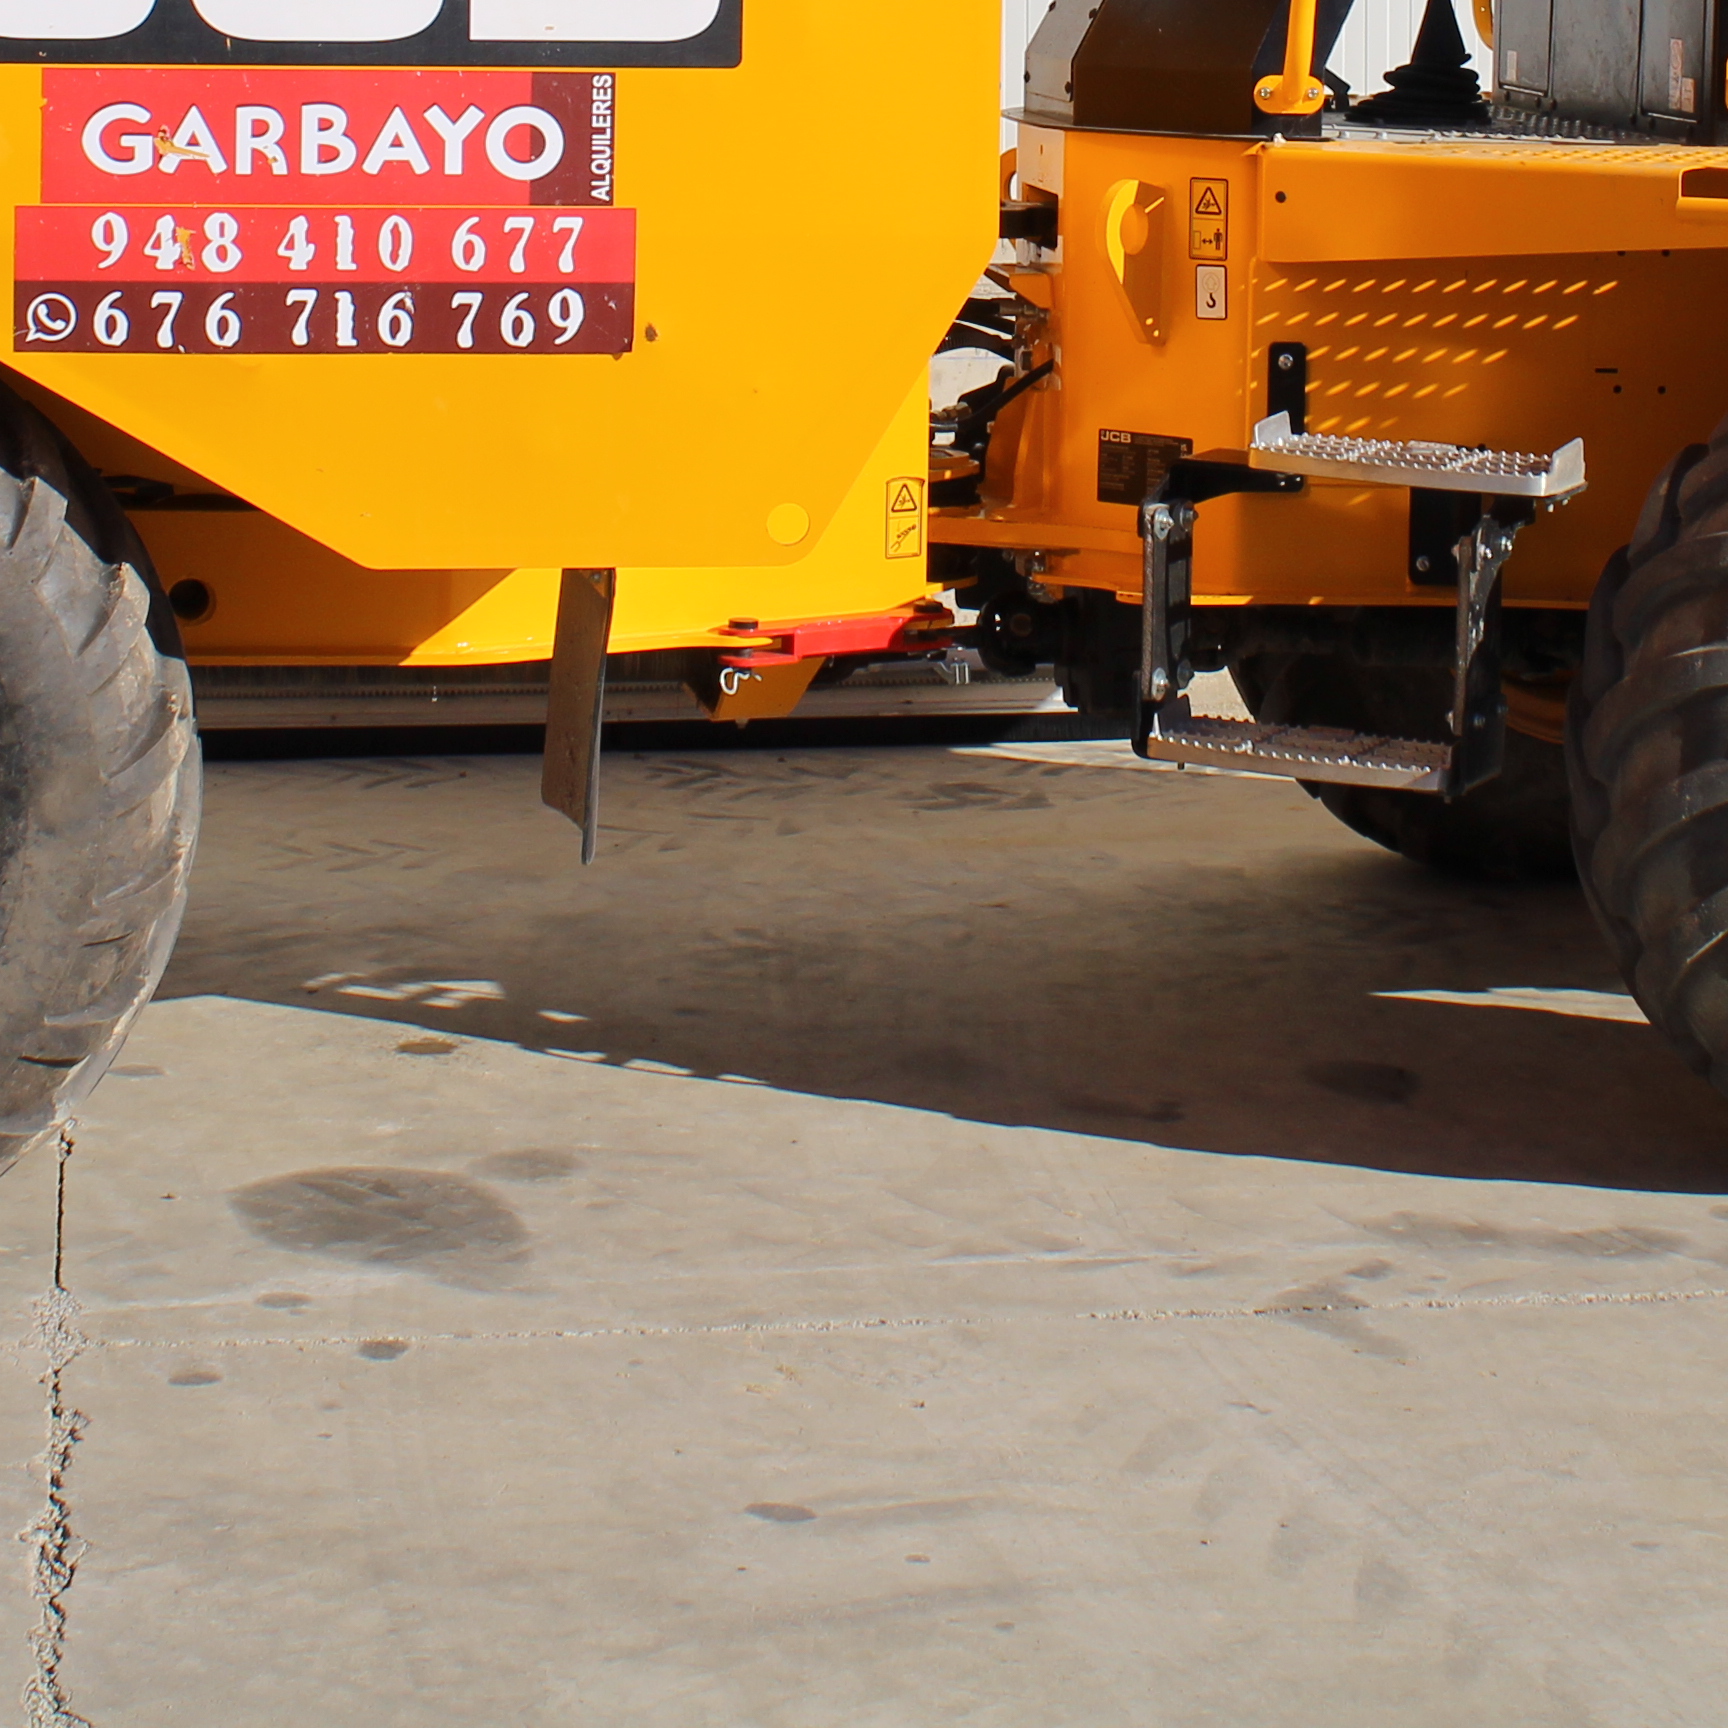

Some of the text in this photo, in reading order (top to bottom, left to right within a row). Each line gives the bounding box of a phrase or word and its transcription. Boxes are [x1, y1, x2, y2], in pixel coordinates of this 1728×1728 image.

[81, 103, 565, 182] GARBAYO
[590, 73, 614, 202] ALQUILERES
[91, 212, 585, 274] 948 410 677
[93, 287, 585, 349] 676 716 769
[1100, 429, 1132, 443] JCB
